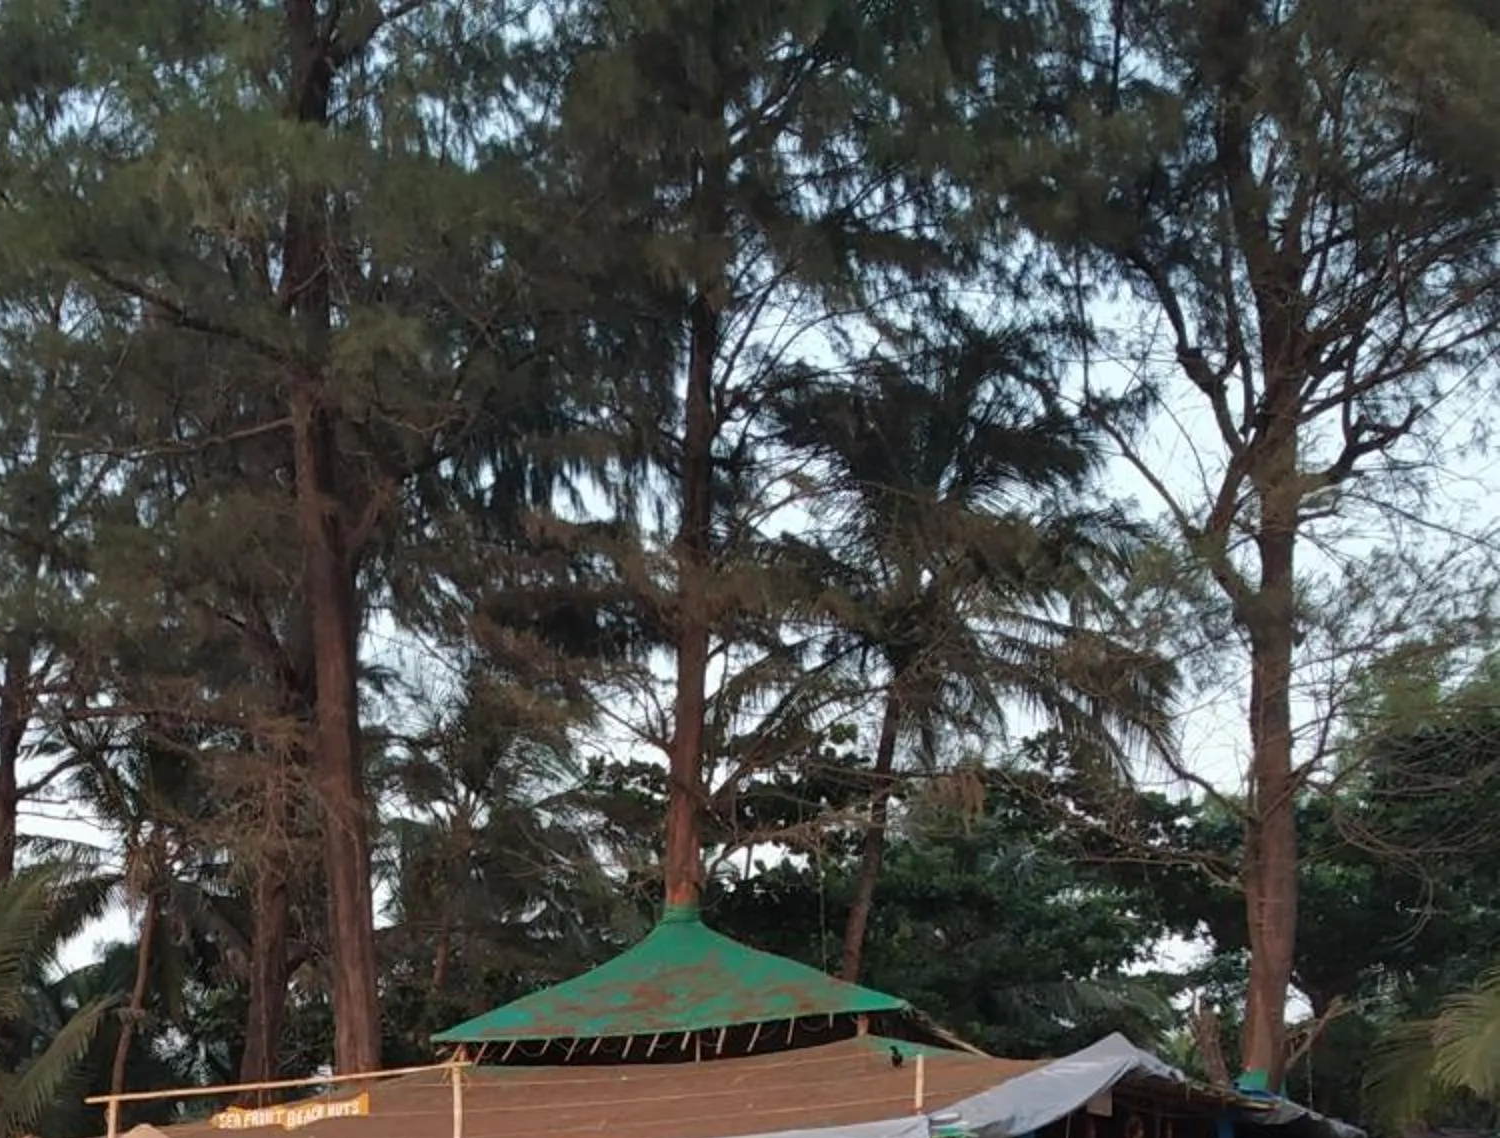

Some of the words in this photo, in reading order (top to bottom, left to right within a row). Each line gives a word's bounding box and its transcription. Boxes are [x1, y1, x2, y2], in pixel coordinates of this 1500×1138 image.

[219, 1111, 242, 1129] SEA
[242, 1107, 282, 1129] FRONT
[286, 1102, 324, 1131] BEACH
[327, 1099, 360, 1116] HUTS
